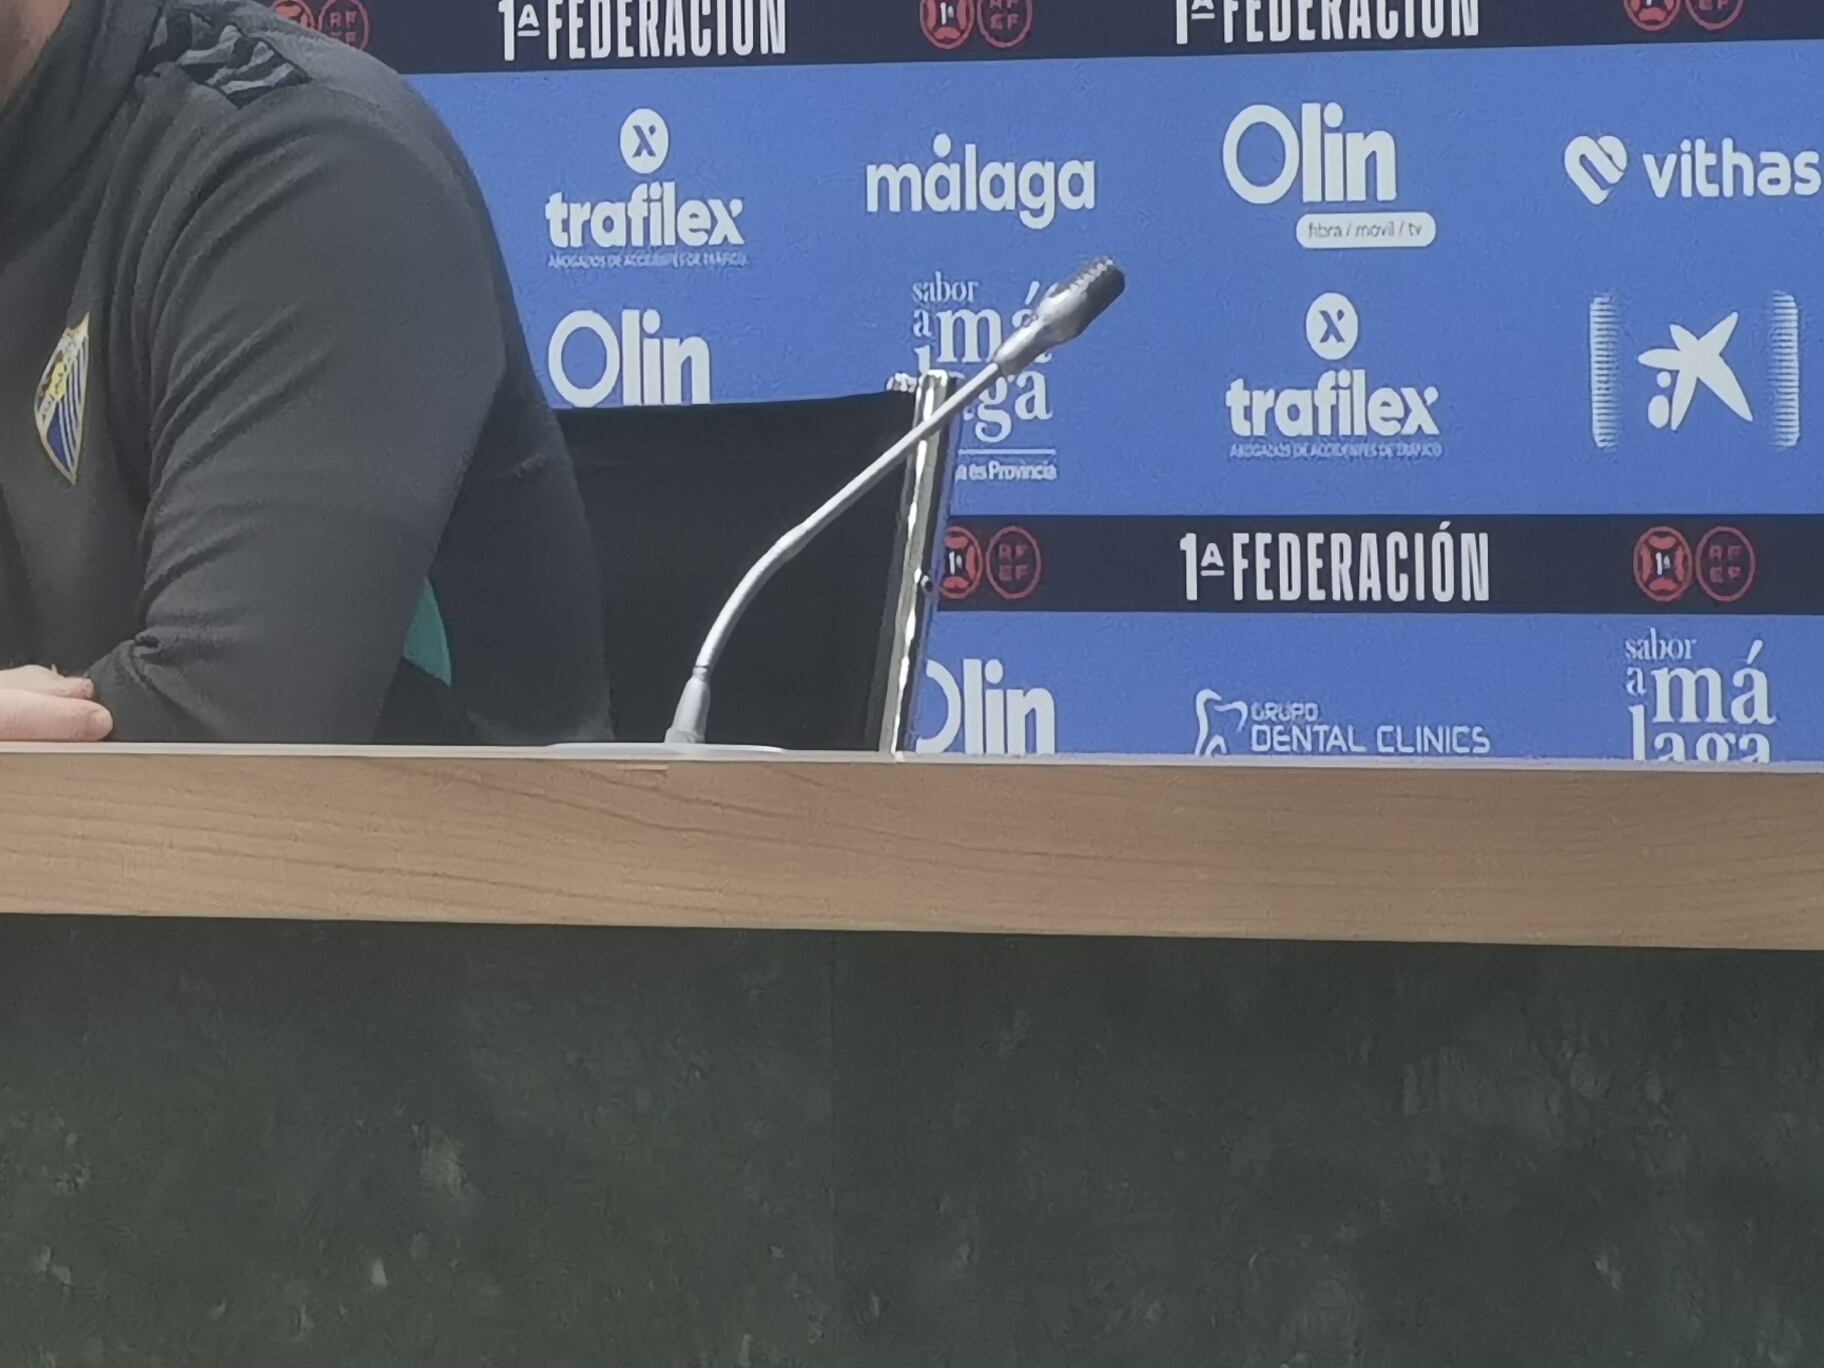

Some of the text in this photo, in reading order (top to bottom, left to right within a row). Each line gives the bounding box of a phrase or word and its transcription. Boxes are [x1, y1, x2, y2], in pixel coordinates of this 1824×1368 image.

[1223, 103, 1396, 203] Olin
[1643, 138, 1821, 198] vithas
[545, 182, 744, 247] trafilex
[913, 271, 978, 302] sabor
[549, 310, 710, 407] Olin
[1226, 369, 1439, 436] trafilex
[1233, 521, 1489, 602] FEDERACIÓN
[1626, 627, 1696, 660] sabor
[1251, 702, 1318, 721] GRUPO
[1627, 636, 1775, 724] a má
[1252, 724, 1490, 753] DENTAL CLINICS
